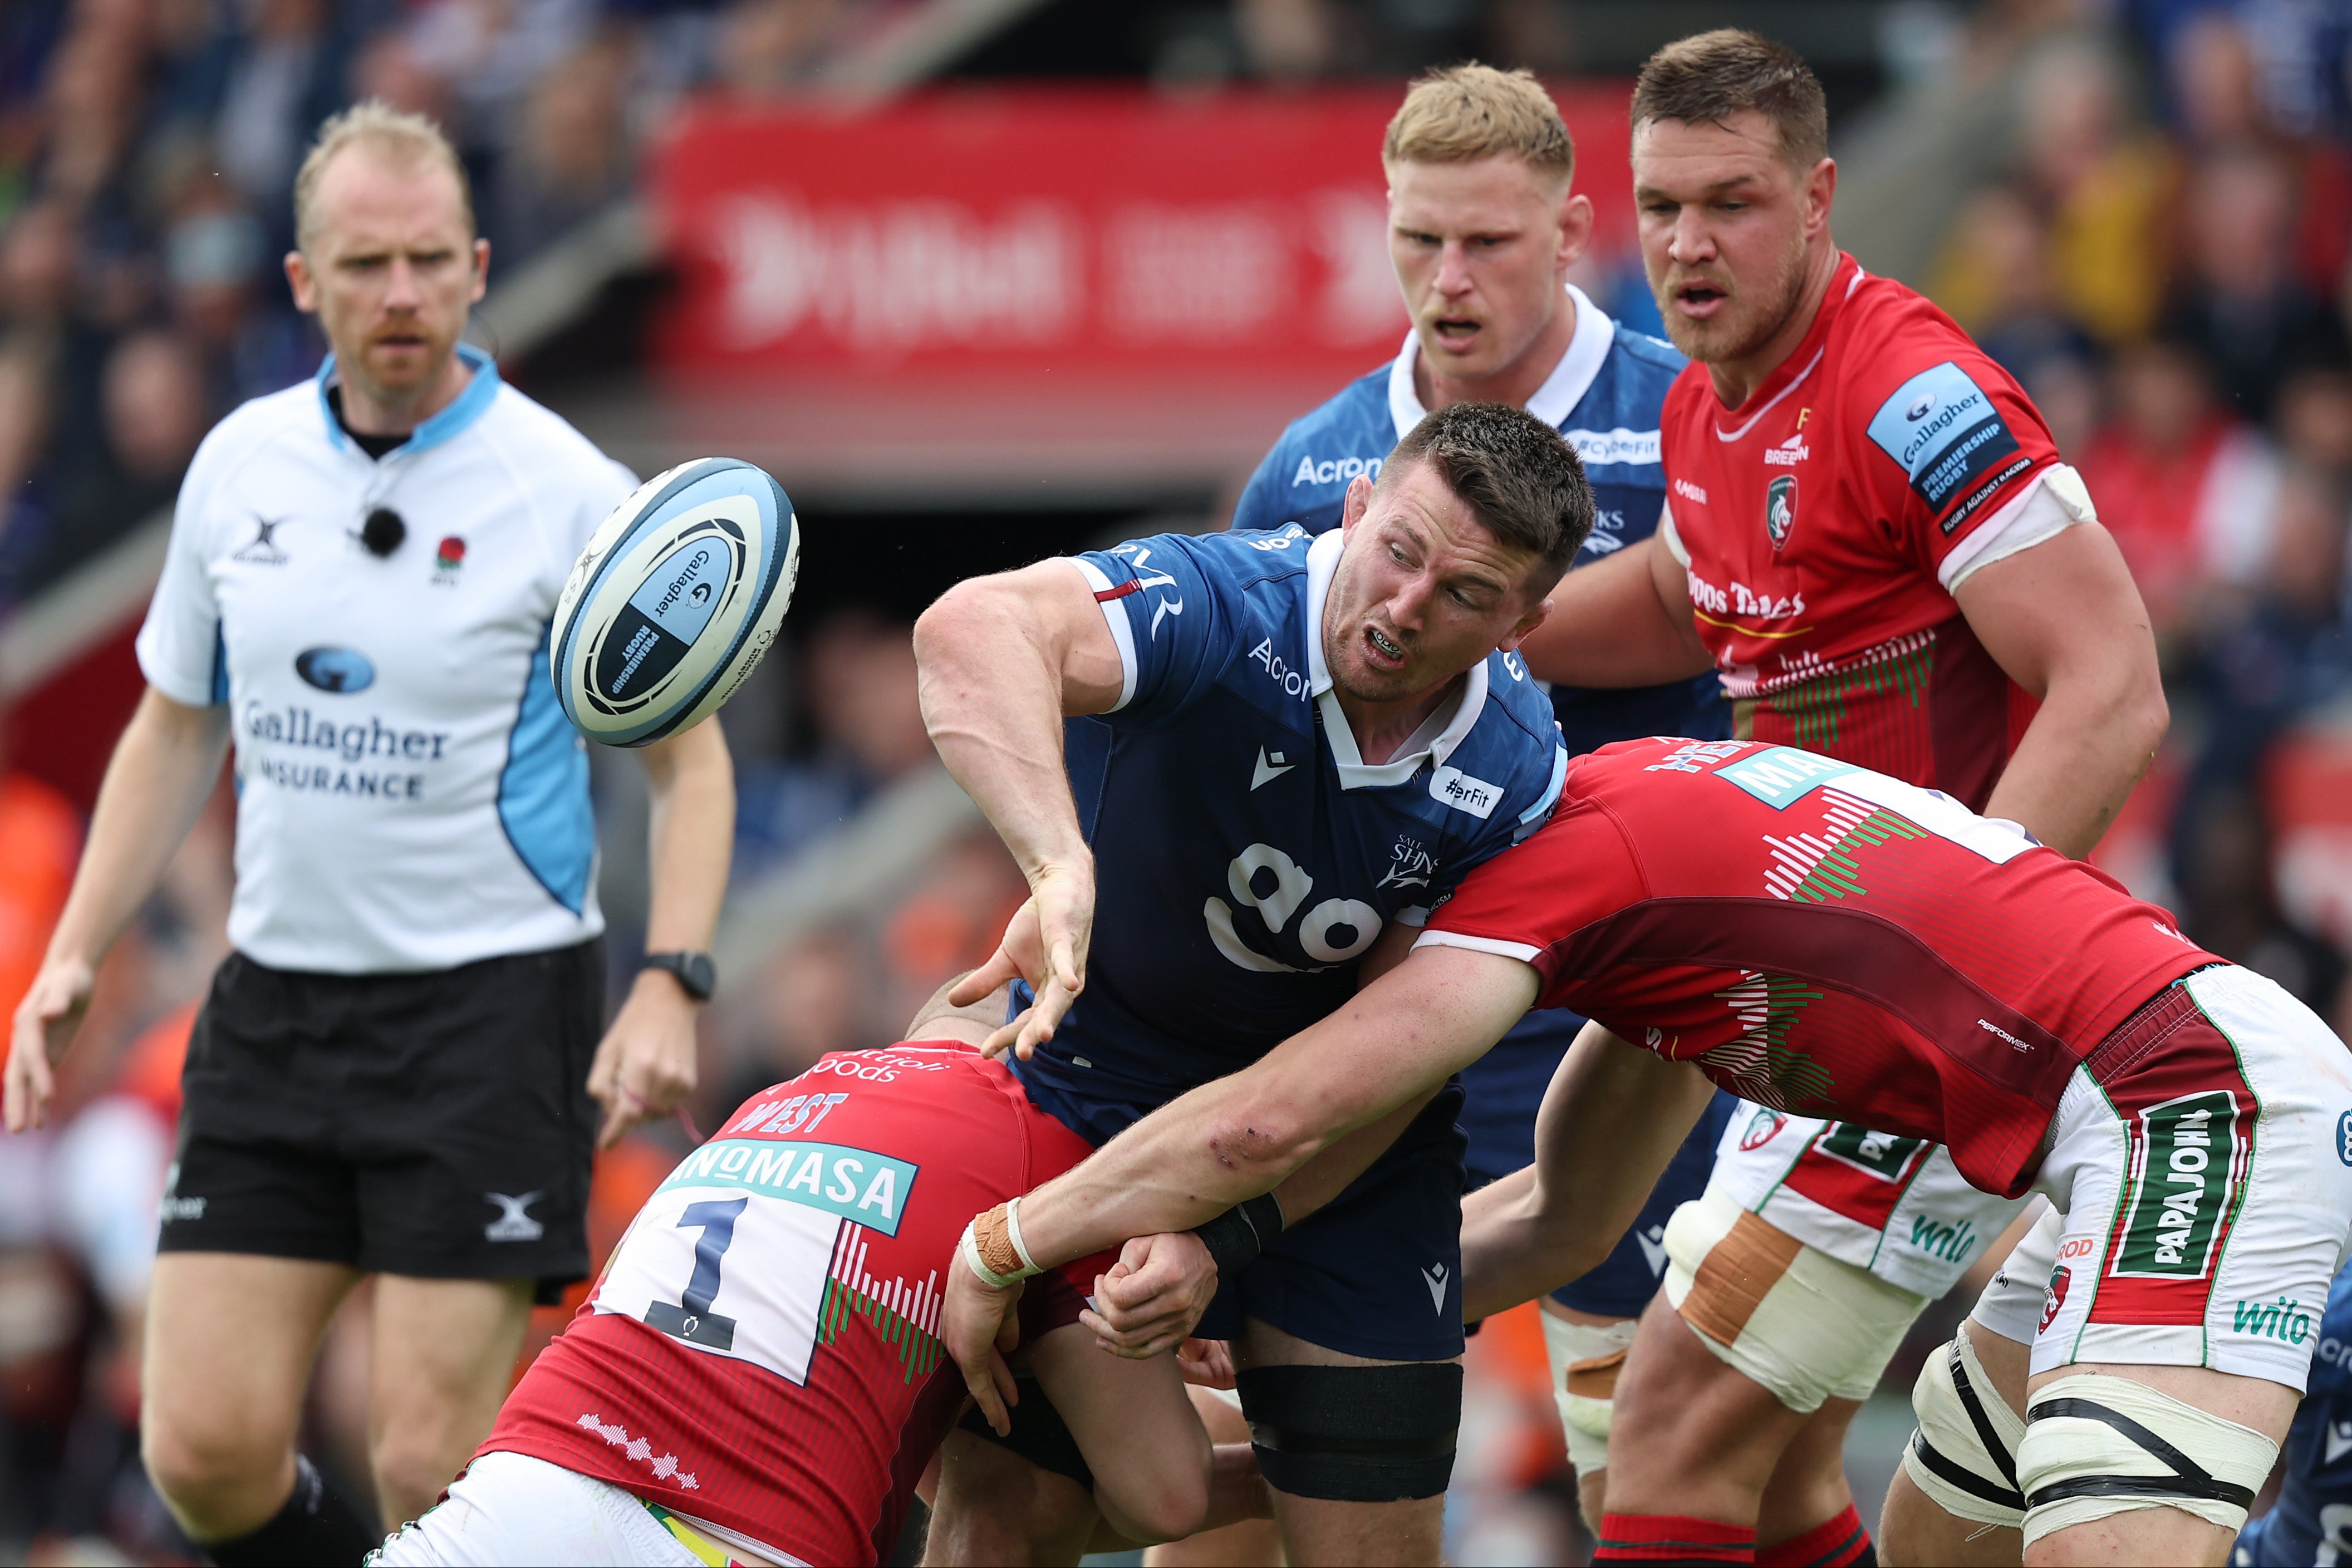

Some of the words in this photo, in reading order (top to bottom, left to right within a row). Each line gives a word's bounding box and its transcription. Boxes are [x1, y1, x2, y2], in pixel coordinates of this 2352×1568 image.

[1903, 393, 1980, 465] Gallagher
[1921, 423, 2001, 493] PREMIERSHIP
[1928, 458, 1969, 502] RUGBY
[1943, 505, 1966, 532] RUGBY
[1966, 479, 1999, 510] AGAINST
[1999, 458, 2031, 482] RACISM
[655, 550, 710, 618] Gallagher
[612, 631, 660, 695] PREMIERSHIP
[622, 624, 651, 661] RUGBY
[247, 700, 450, 761] Gallagher
[1397, 834, 1425, 851] SALE
[728, 1093, 850, 1134] WEST
[1911, 1214, 1976, 1263] wilo
[643, 1197, 749, 1353] 1
[2233, 1296, 2310, 1345] wilo
